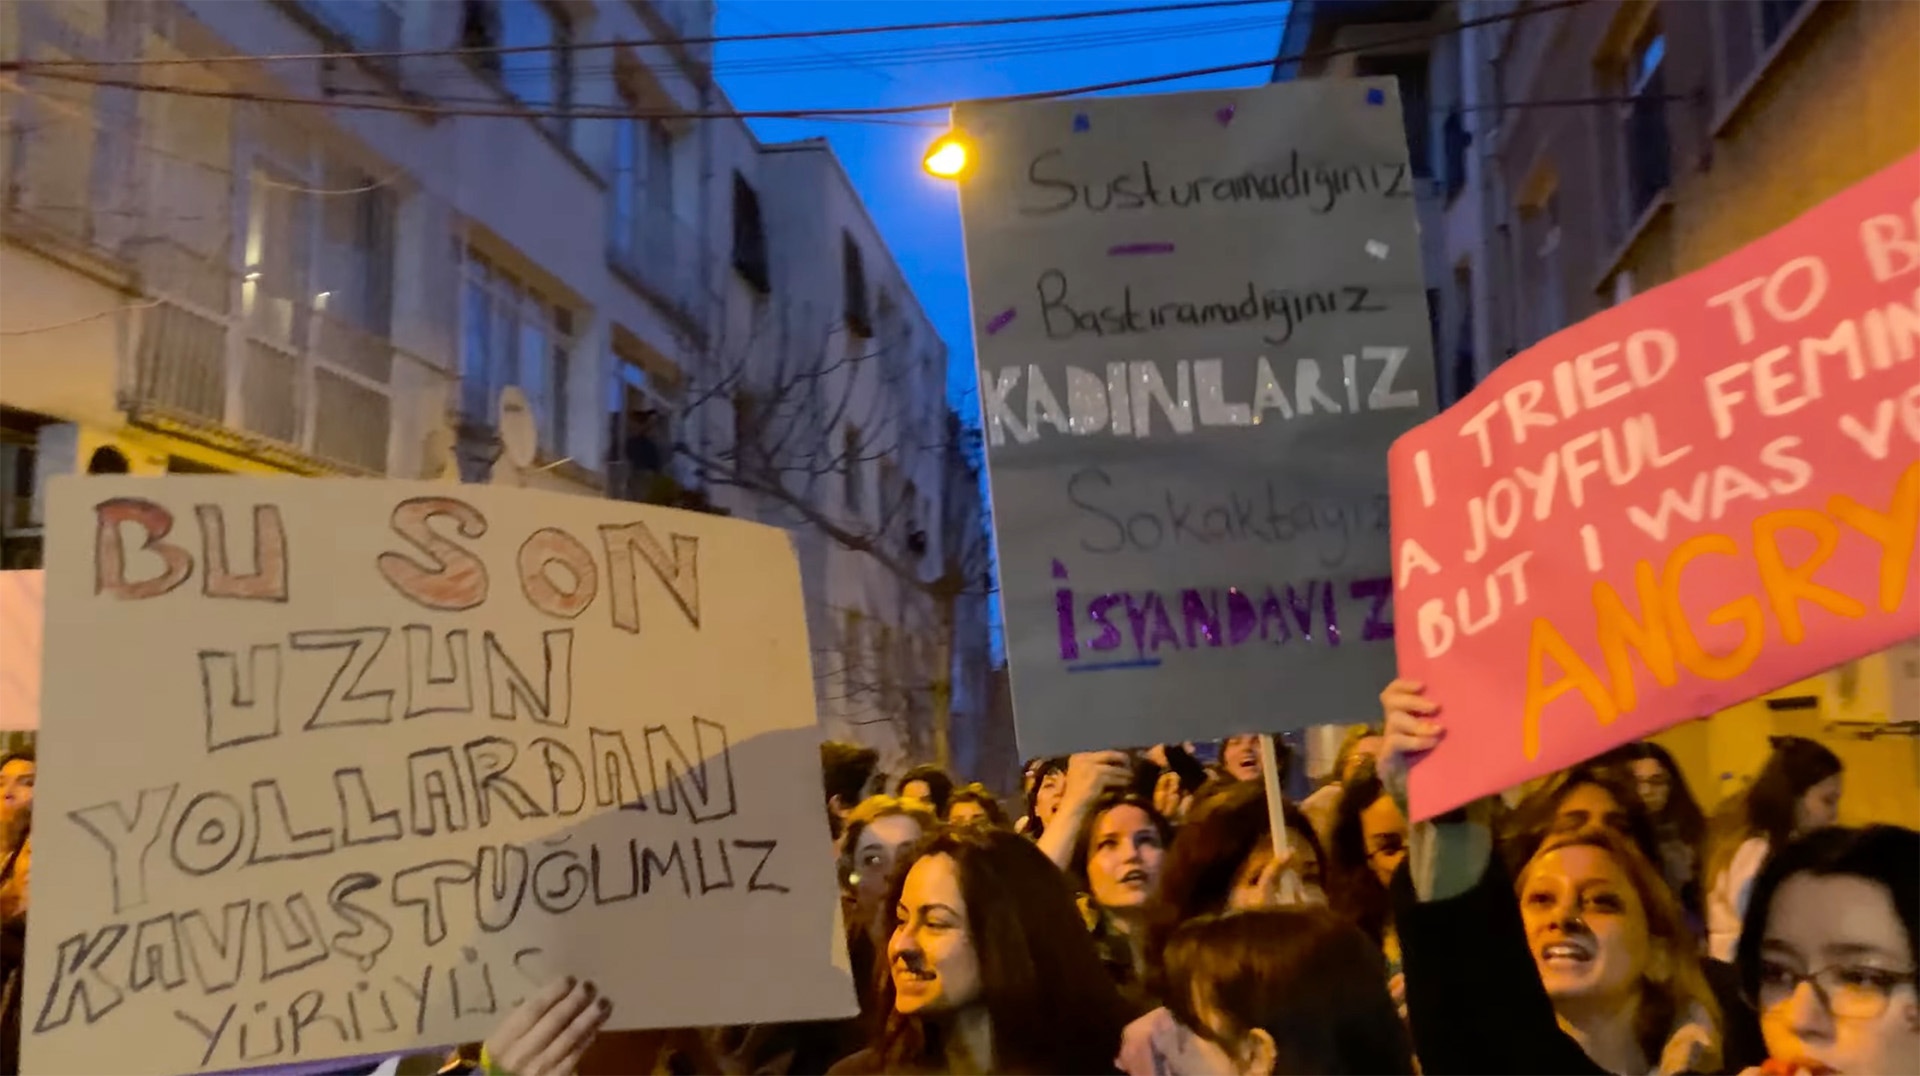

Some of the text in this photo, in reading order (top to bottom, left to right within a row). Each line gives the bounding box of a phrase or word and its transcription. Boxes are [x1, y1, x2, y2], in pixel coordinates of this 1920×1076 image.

[982, 346, 1419, 446] KADINLARIZ
[1415, 195, 1920, 508] I TRIED TO B
[93, 496, 700, 633] BU SON
[1400, 539, 1441, 590] A
[1464, 413, 1693, 564] JOYFUL
[1417, 552, 1533, 659] BUT
[1581, 525, 1602, 572] I
[1628, 436, 1813, 541] WAS
[198, 625, 574, 754] UZUN
[1523, 462, 1920, 762] ANGRY
[70, 716, 737, 915] YOLLARDAN
